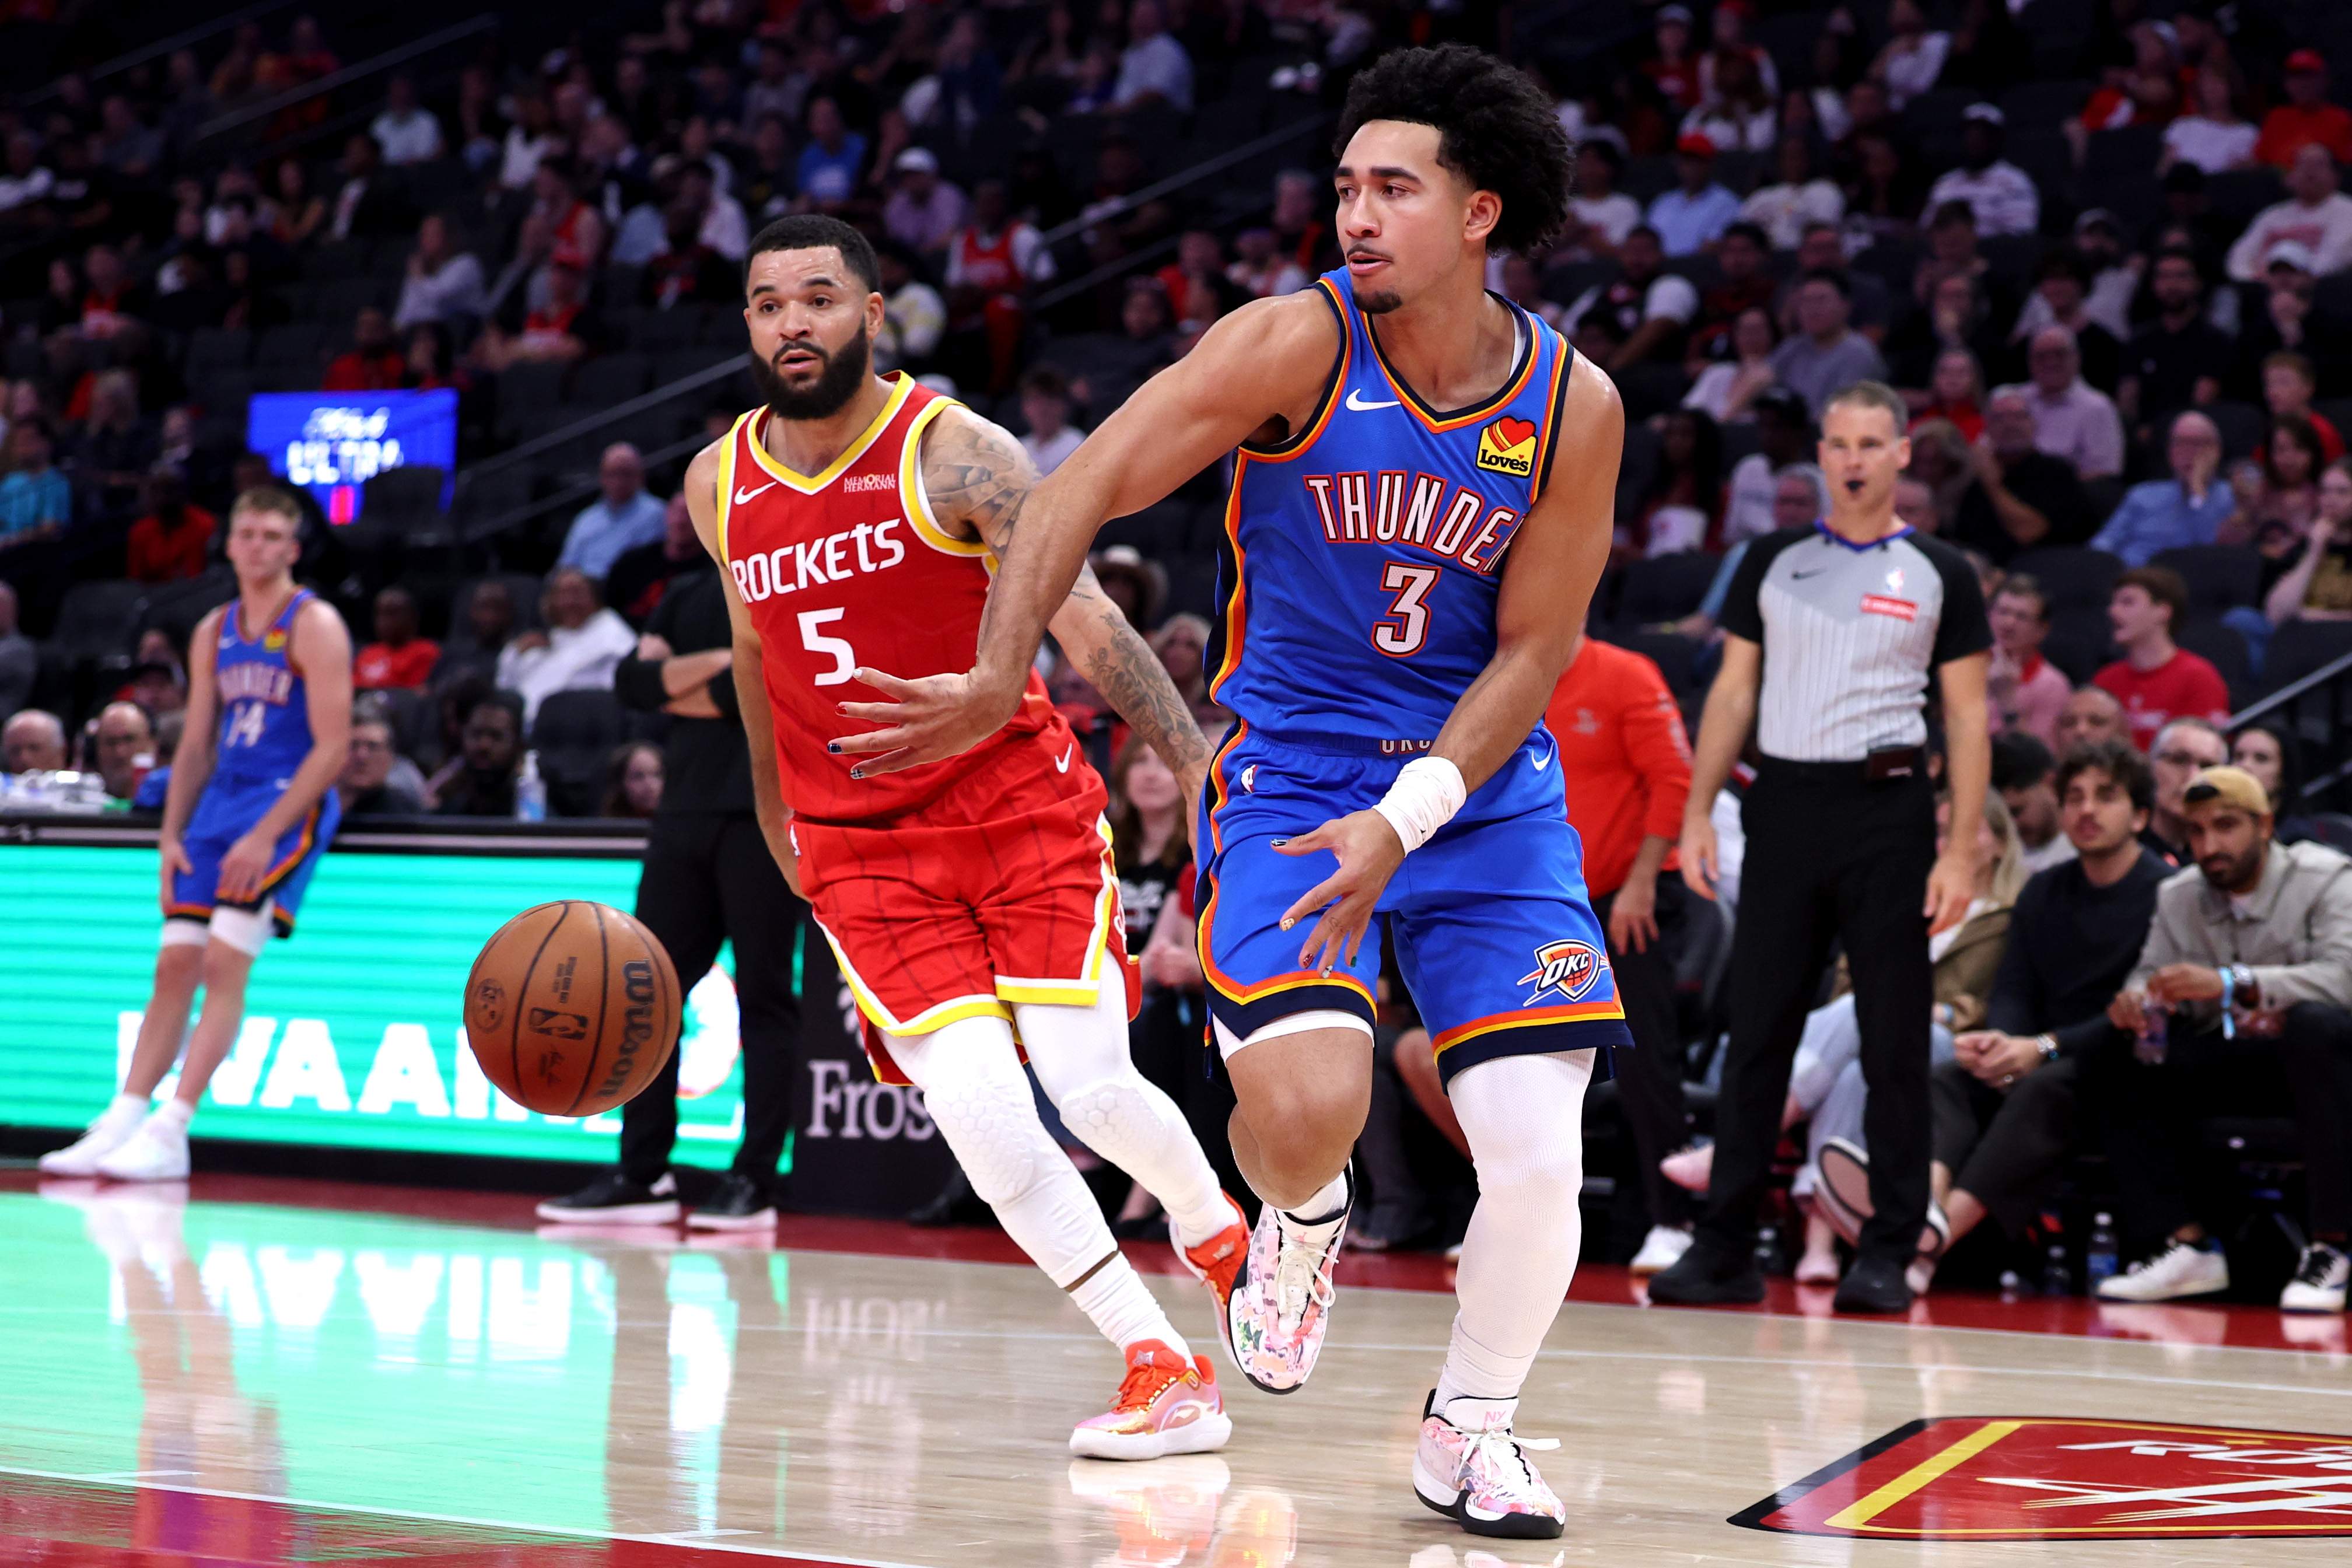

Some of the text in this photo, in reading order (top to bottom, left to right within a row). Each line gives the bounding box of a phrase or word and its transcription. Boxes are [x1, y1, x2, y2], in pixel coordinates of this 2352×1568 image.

[844, 473, 896, 485] MEMORIAL
[844, 481, 896, 493] HERMANN
[1371, 560, 1442, 658] 3
[796, 607, 856, 686] 5
[1538, 951, 1590, 990] OKC
[595, 958, 655, 1098] Wilson
[804, 1059, 936, 1140] Fros
[1483, 1410, 1507, 1430] NY
